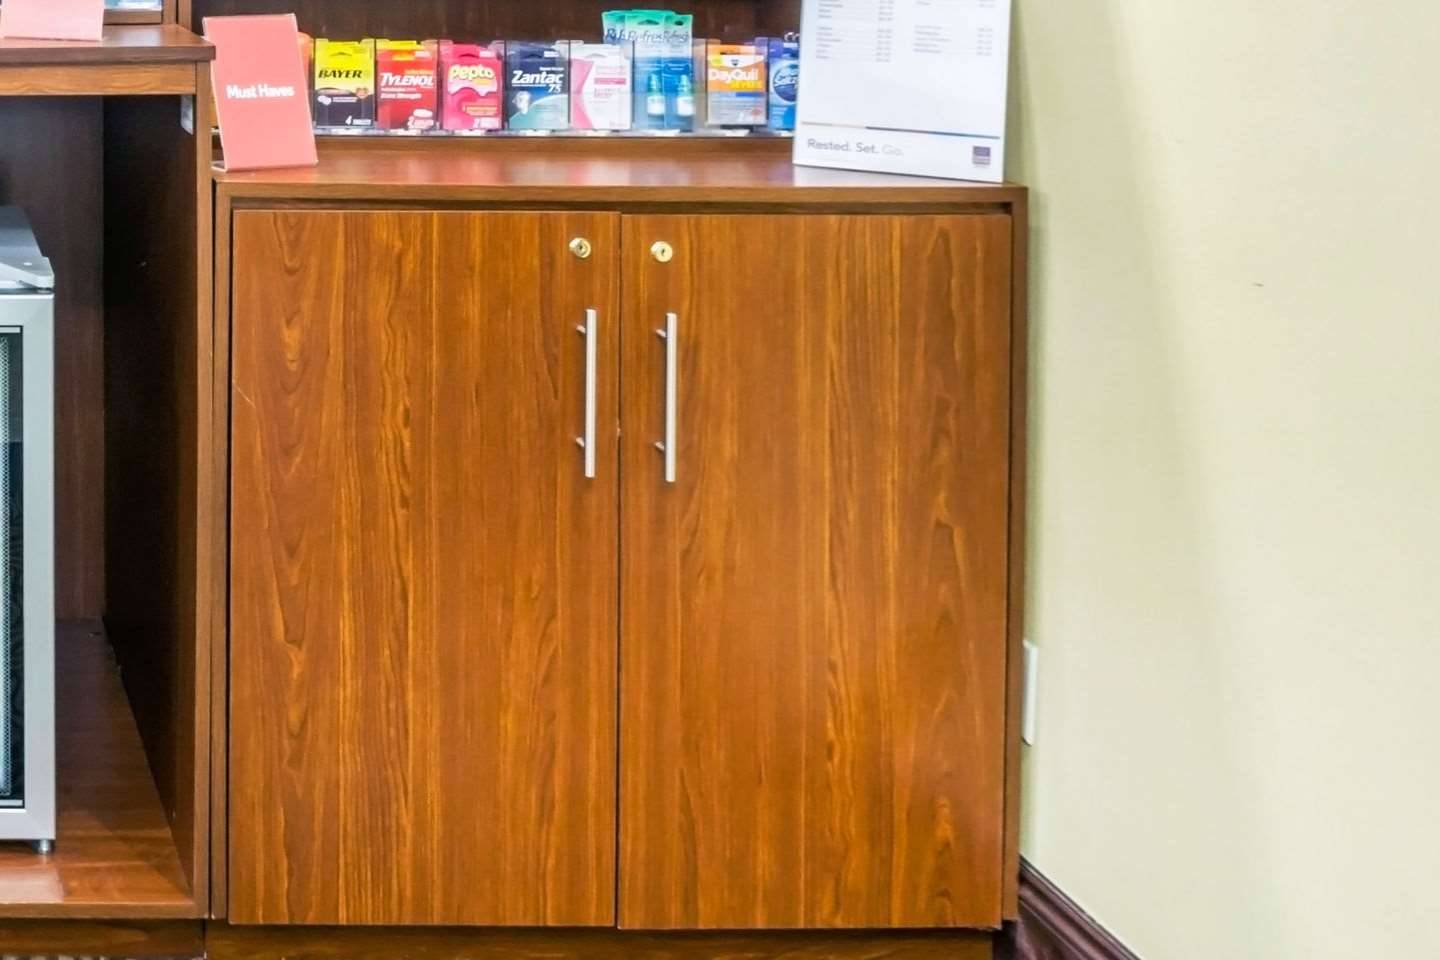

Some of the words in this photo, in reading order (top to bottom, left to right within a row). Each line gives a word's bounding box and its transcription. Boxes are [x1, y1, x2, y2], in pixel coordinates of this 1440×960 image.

[318, 69, 362, 79] BAYER
[380, 72, 434, 87] TYLENOL
[512, 70, 564, 84] Zantac
[708, 68, 759, 84] DayQuil
[227, 85, 257, 99] Must
[258, 83, 294, 98] Haves
[548, 84, 562, 93] 75
[808, 138, 852, 152] Rested.
[856, 142, 879, 154] Set.
